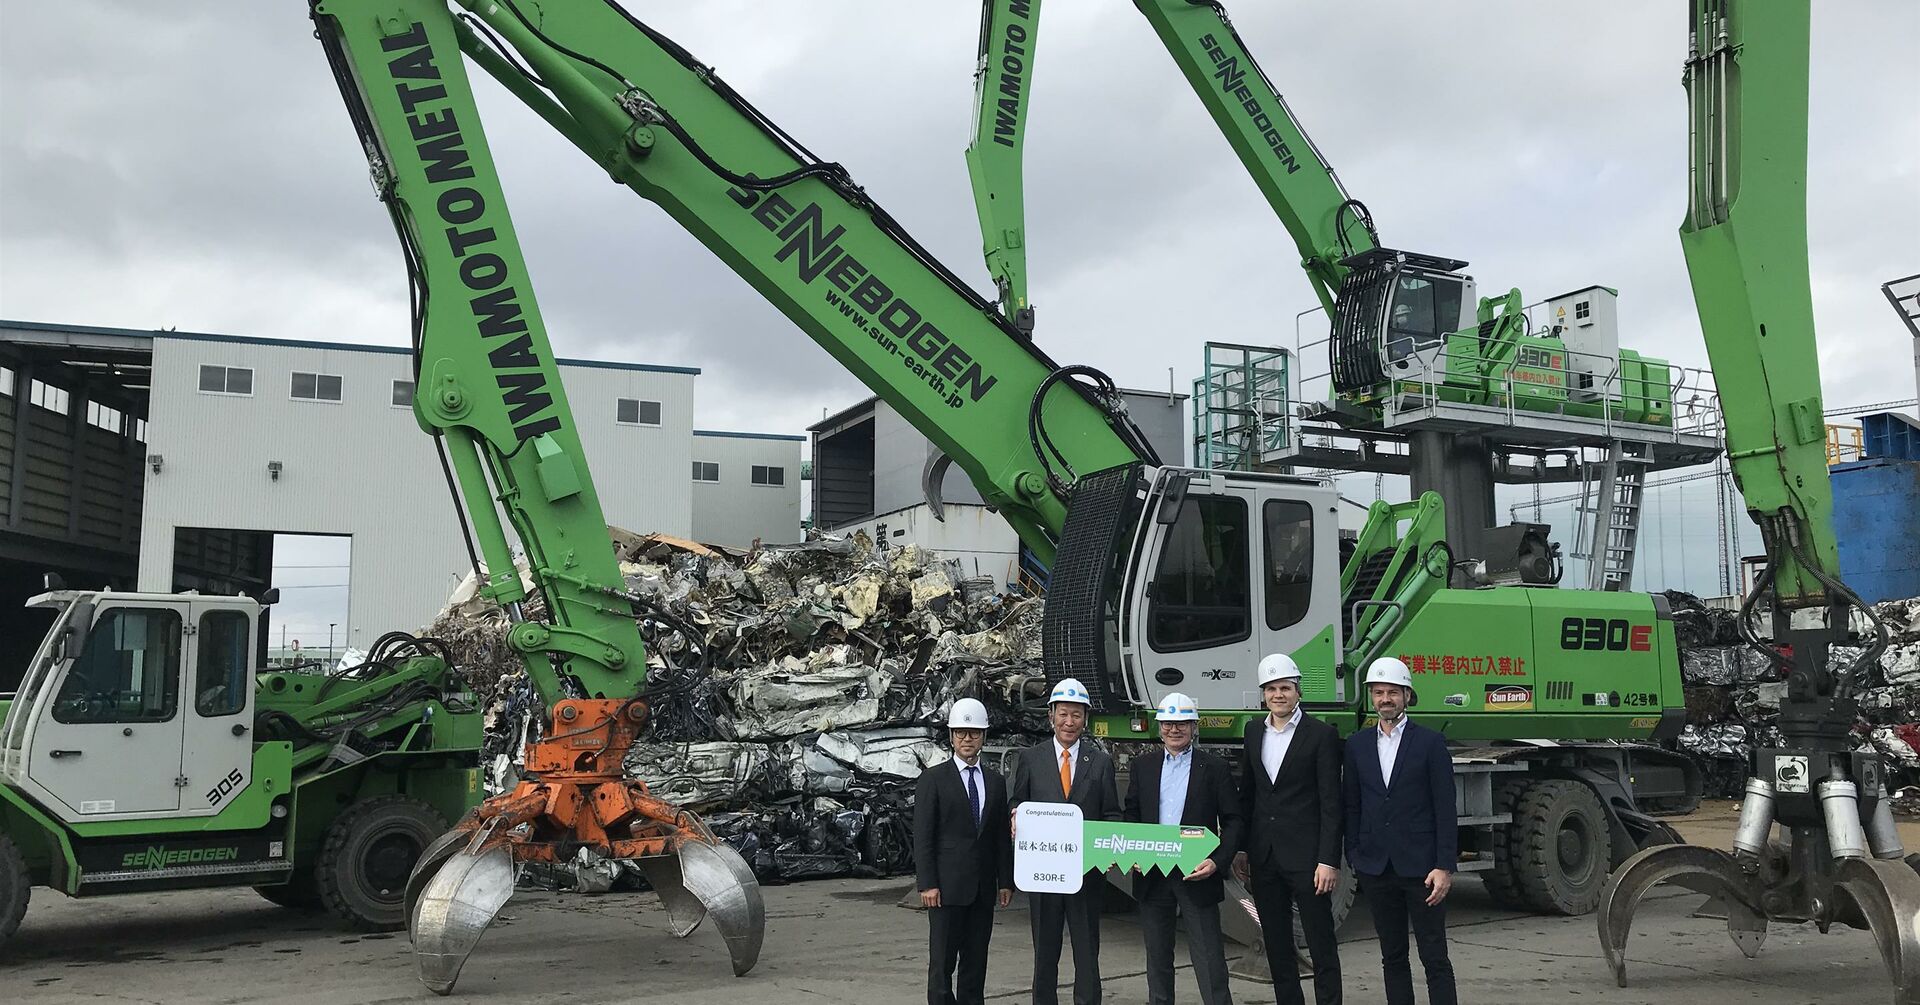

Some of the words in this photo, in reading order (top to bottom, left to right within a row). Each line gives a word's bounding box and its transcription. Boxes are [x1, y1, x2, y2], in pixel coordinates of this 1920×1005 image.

[993, 24, 1027, 148] IWAMOTO
[1198, 33, 1301, 175] SENNEBOGEN
[825, 289, 964, 409] www.sun-earth.jp
[1561, 617, 1653, 652] 830E
[1492, 693, 1506, 702] Sun
[1507, 692, 1527, 702] Earth
[1623, 693, 1658, 706] 42号機
[206, 767, 244, 807] 305
[1025, 809, 1074, 817] Congratulations!
[1093, 833, 1182, 854] SENNEBOGEN
[122, 845, 239, 870] SENNEBOGEN
[1033, 872, 1066, 882] 830R-E
